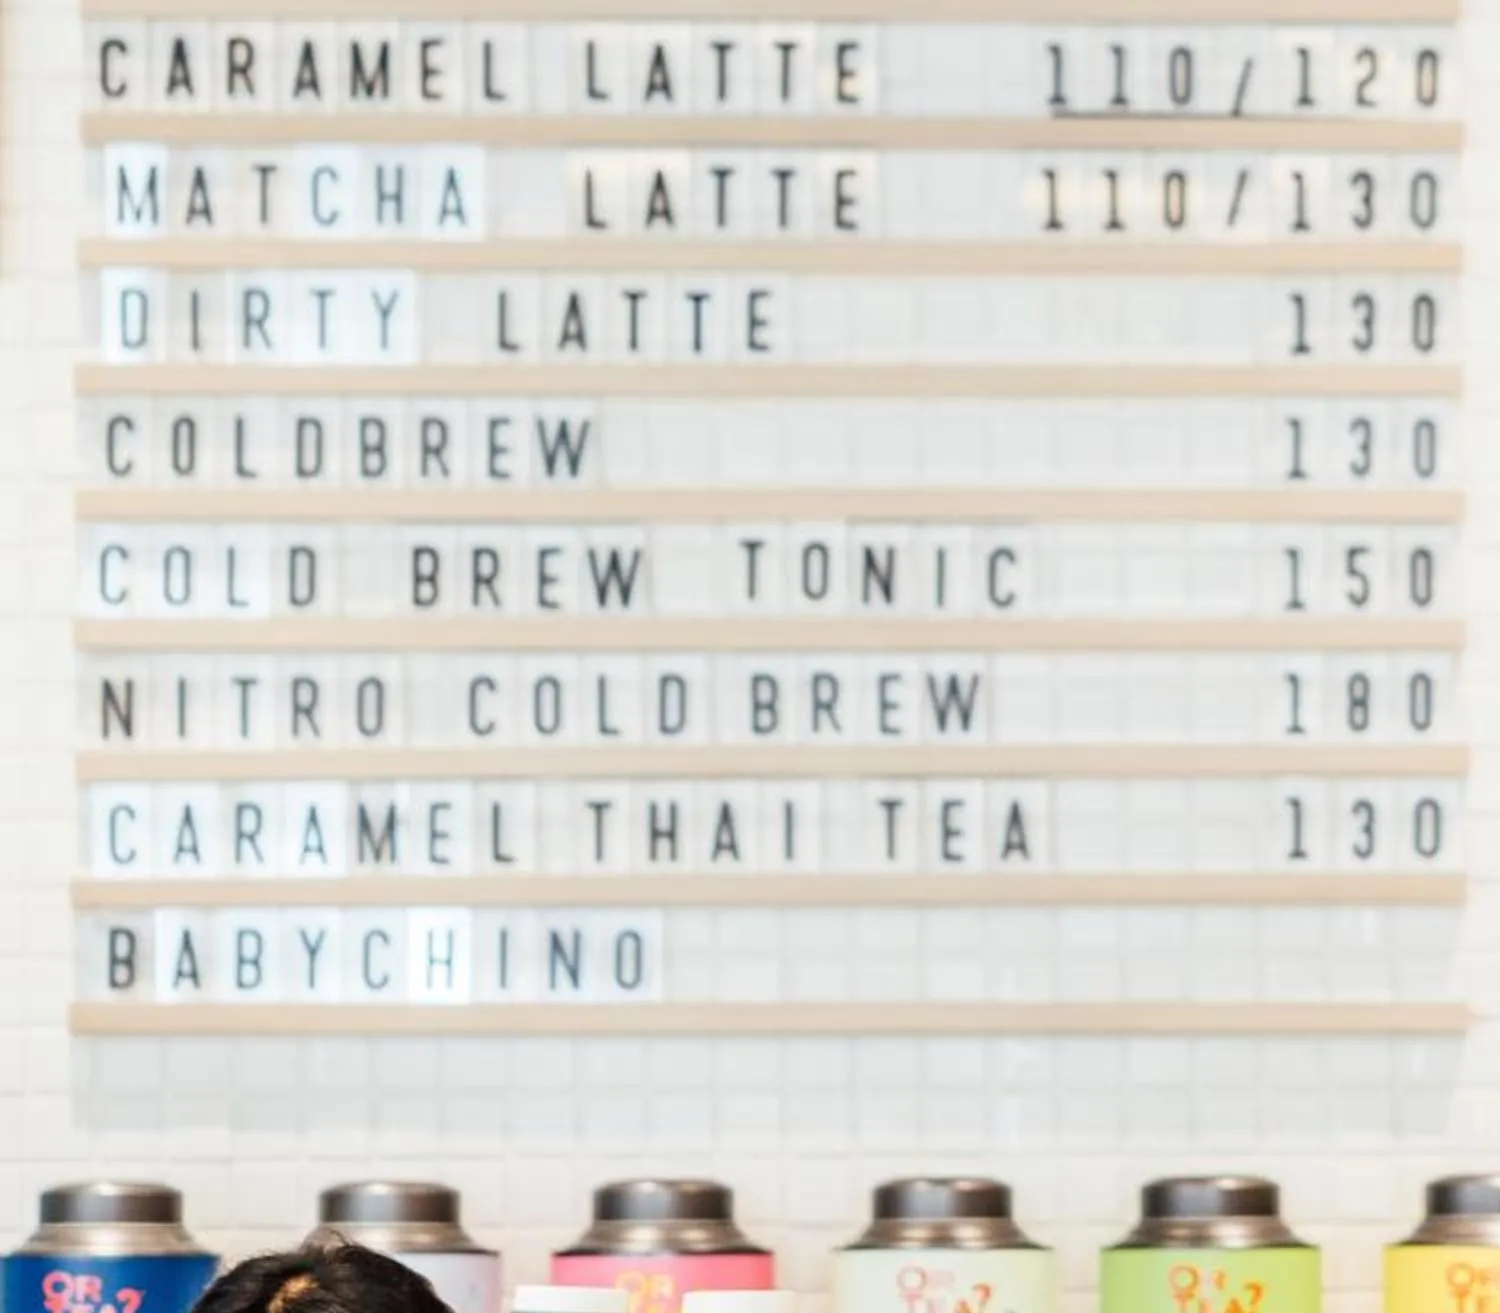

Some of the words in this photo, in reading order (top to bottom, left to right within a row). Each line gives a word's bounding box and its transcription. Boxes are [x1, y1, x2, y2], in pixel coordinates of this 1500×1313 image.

[98, 35, 506, 103] CARAMEL
[584, 39, 860, 106] LATTE
[1047, 42, 1441, 117] 110/120
[117, 163, 466, 227] MATCHA
[583, 165, 858, 232] LATTE
[1041, 167, 1438, 234] 110/130
[120, 287, 399, 353] DIRTY
[496, 288, 771, 355] LATTE
[1289, 291, 1437, 357] 130
[105, 413, 592, 481] COLDBREW
[1287, 416, 1437, 481] 130
[99, 544, 317, 609] COLD
[411, 544, 643, 611] BREW
[739, 538, 1018, 610] TONIC
[1284, 544, 1434, 611] 150
[101, 675, 385, 740] NITRO
[467, 672, 688, 738] COLD
[750, 671, 980, 736] BREW
[1286, 671, 1434, 736] 180
[108, 800, 515, 866] CARAMEL
[586, 799, 796, 863] THAI
[878, 797, 1030, 863] TEA
[1287, 796, 1442, 861] 130
[107, 926, 643, 991] BABYCHINO
[42, 1270, 103, 1303] OR
